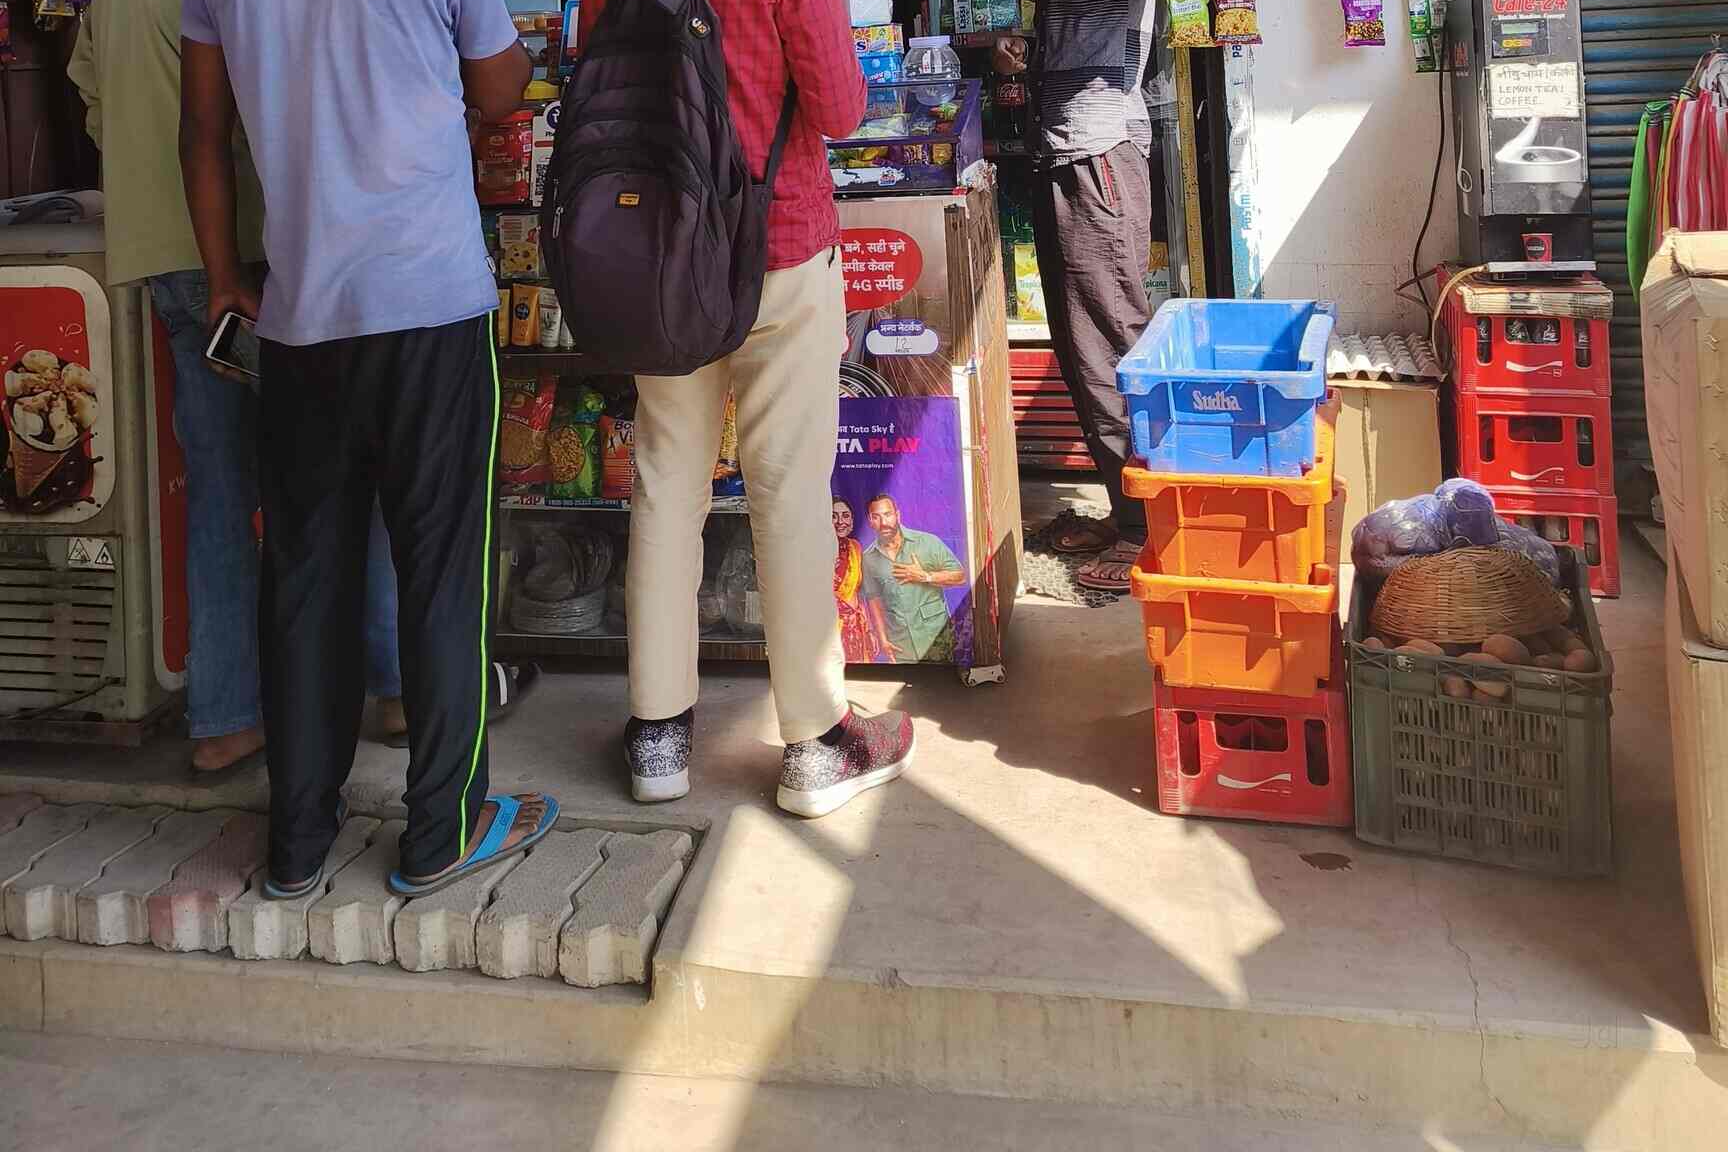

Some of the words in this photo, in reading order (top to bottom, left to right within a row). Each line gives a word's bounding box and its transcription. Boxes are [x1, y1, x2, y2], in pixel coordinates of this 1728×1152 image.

[852, 279, 872, 291] 4G
[1191, 390, 1242, 412] Sudha
[871, 425, 887, 434] Sky
[838, 438, 864, 453] TA
[868, 438, 920, 453] PLAY
